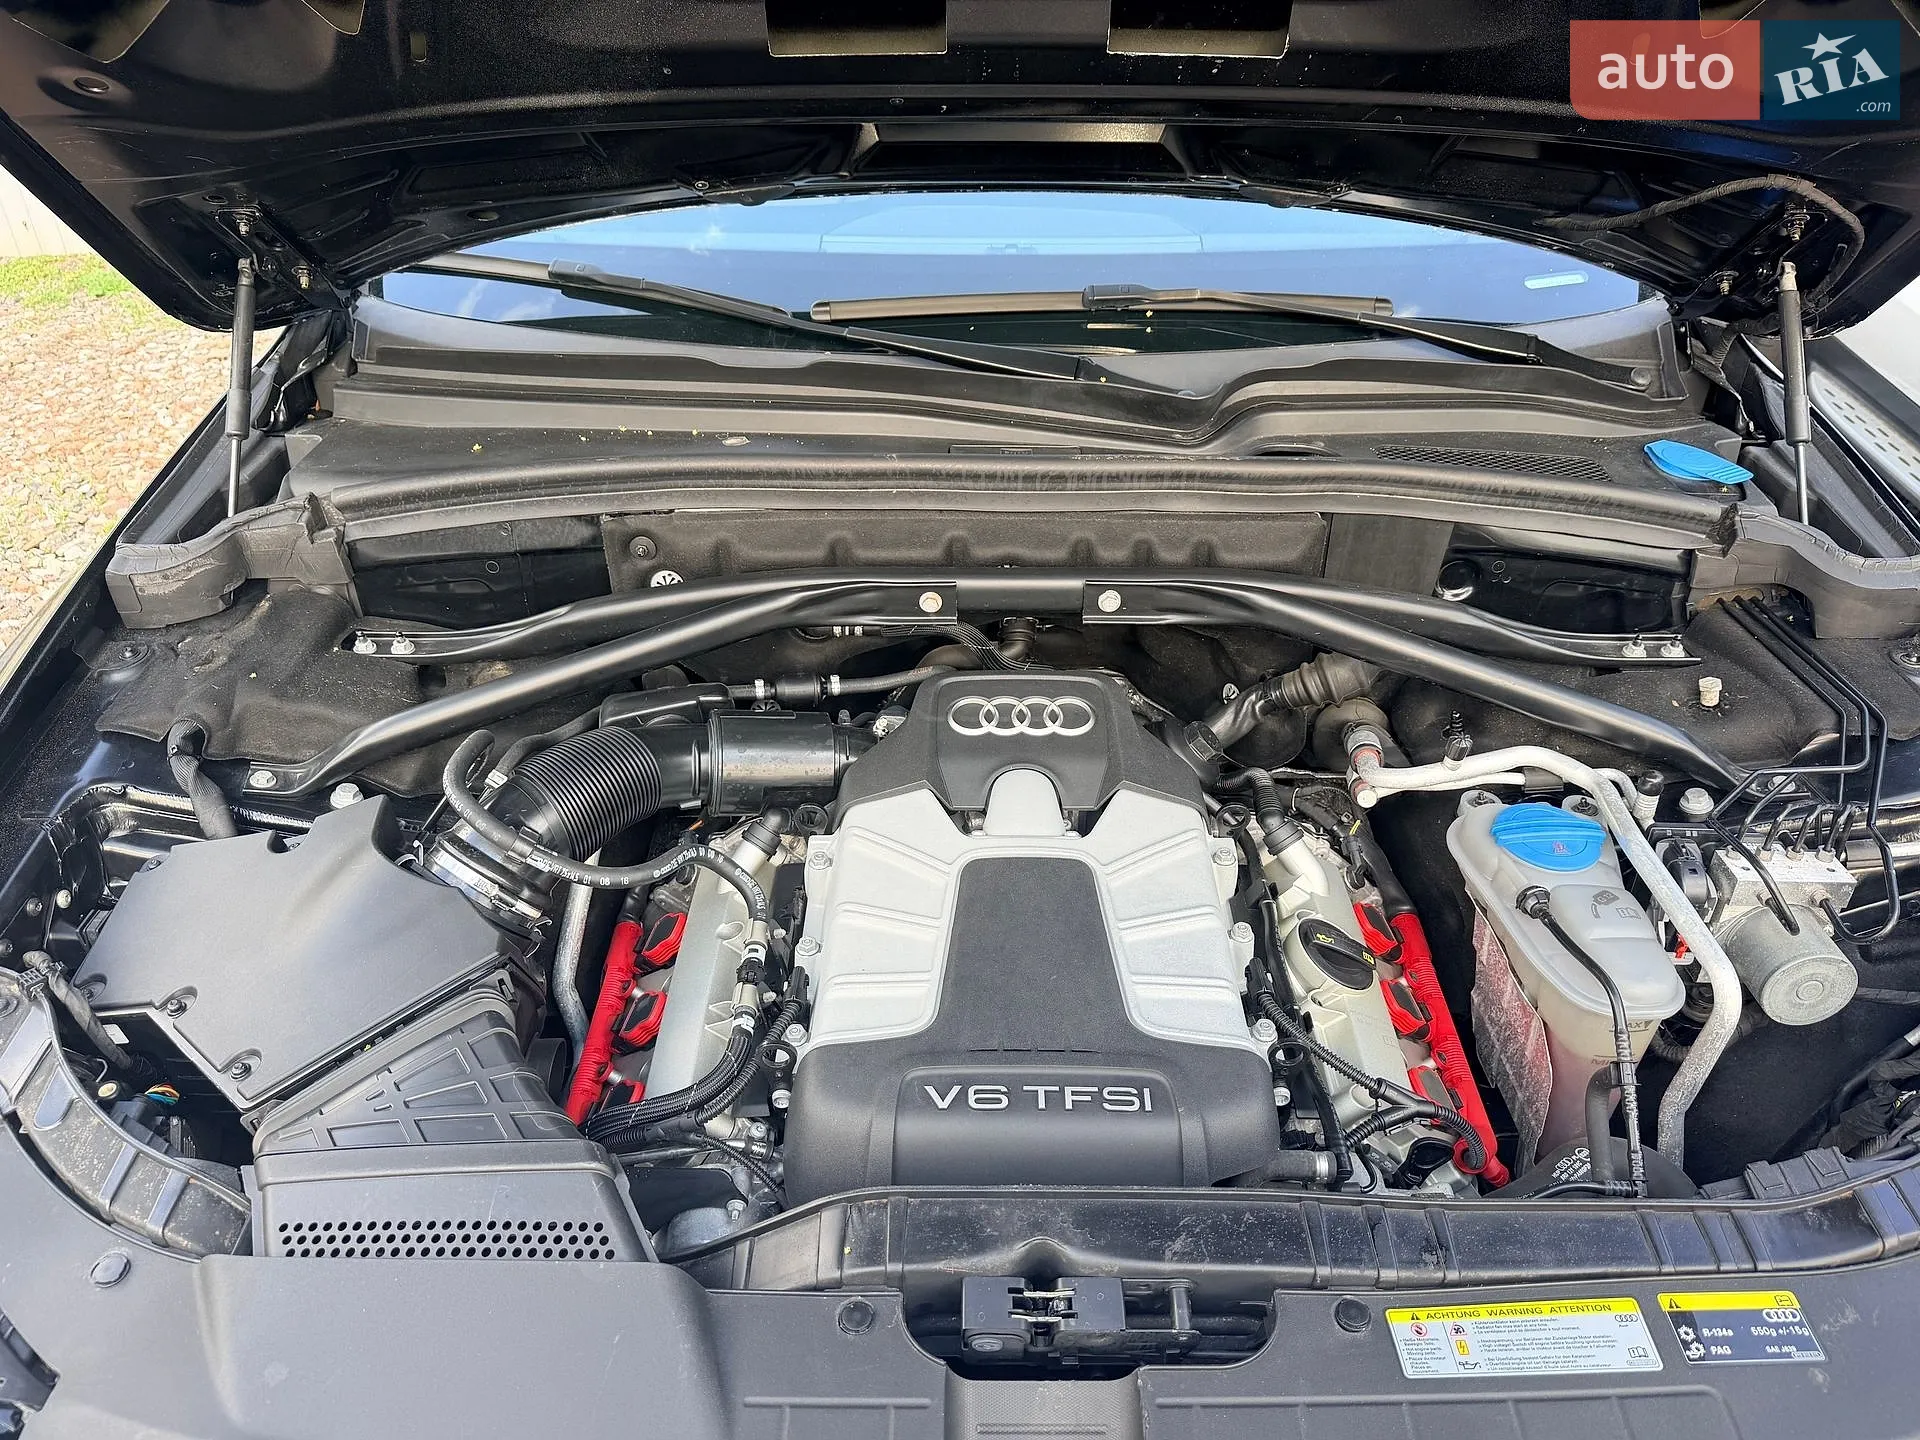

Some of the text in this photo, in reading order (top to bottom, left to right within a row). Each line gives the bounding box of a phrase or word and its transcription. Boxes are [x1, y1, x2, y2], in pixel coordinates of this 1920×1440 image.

[924, 1085, 1153, 1112] V6 TFSI
[1426, 1303, 1612, 1320] ACHTUNG WARNING ATTENTION
